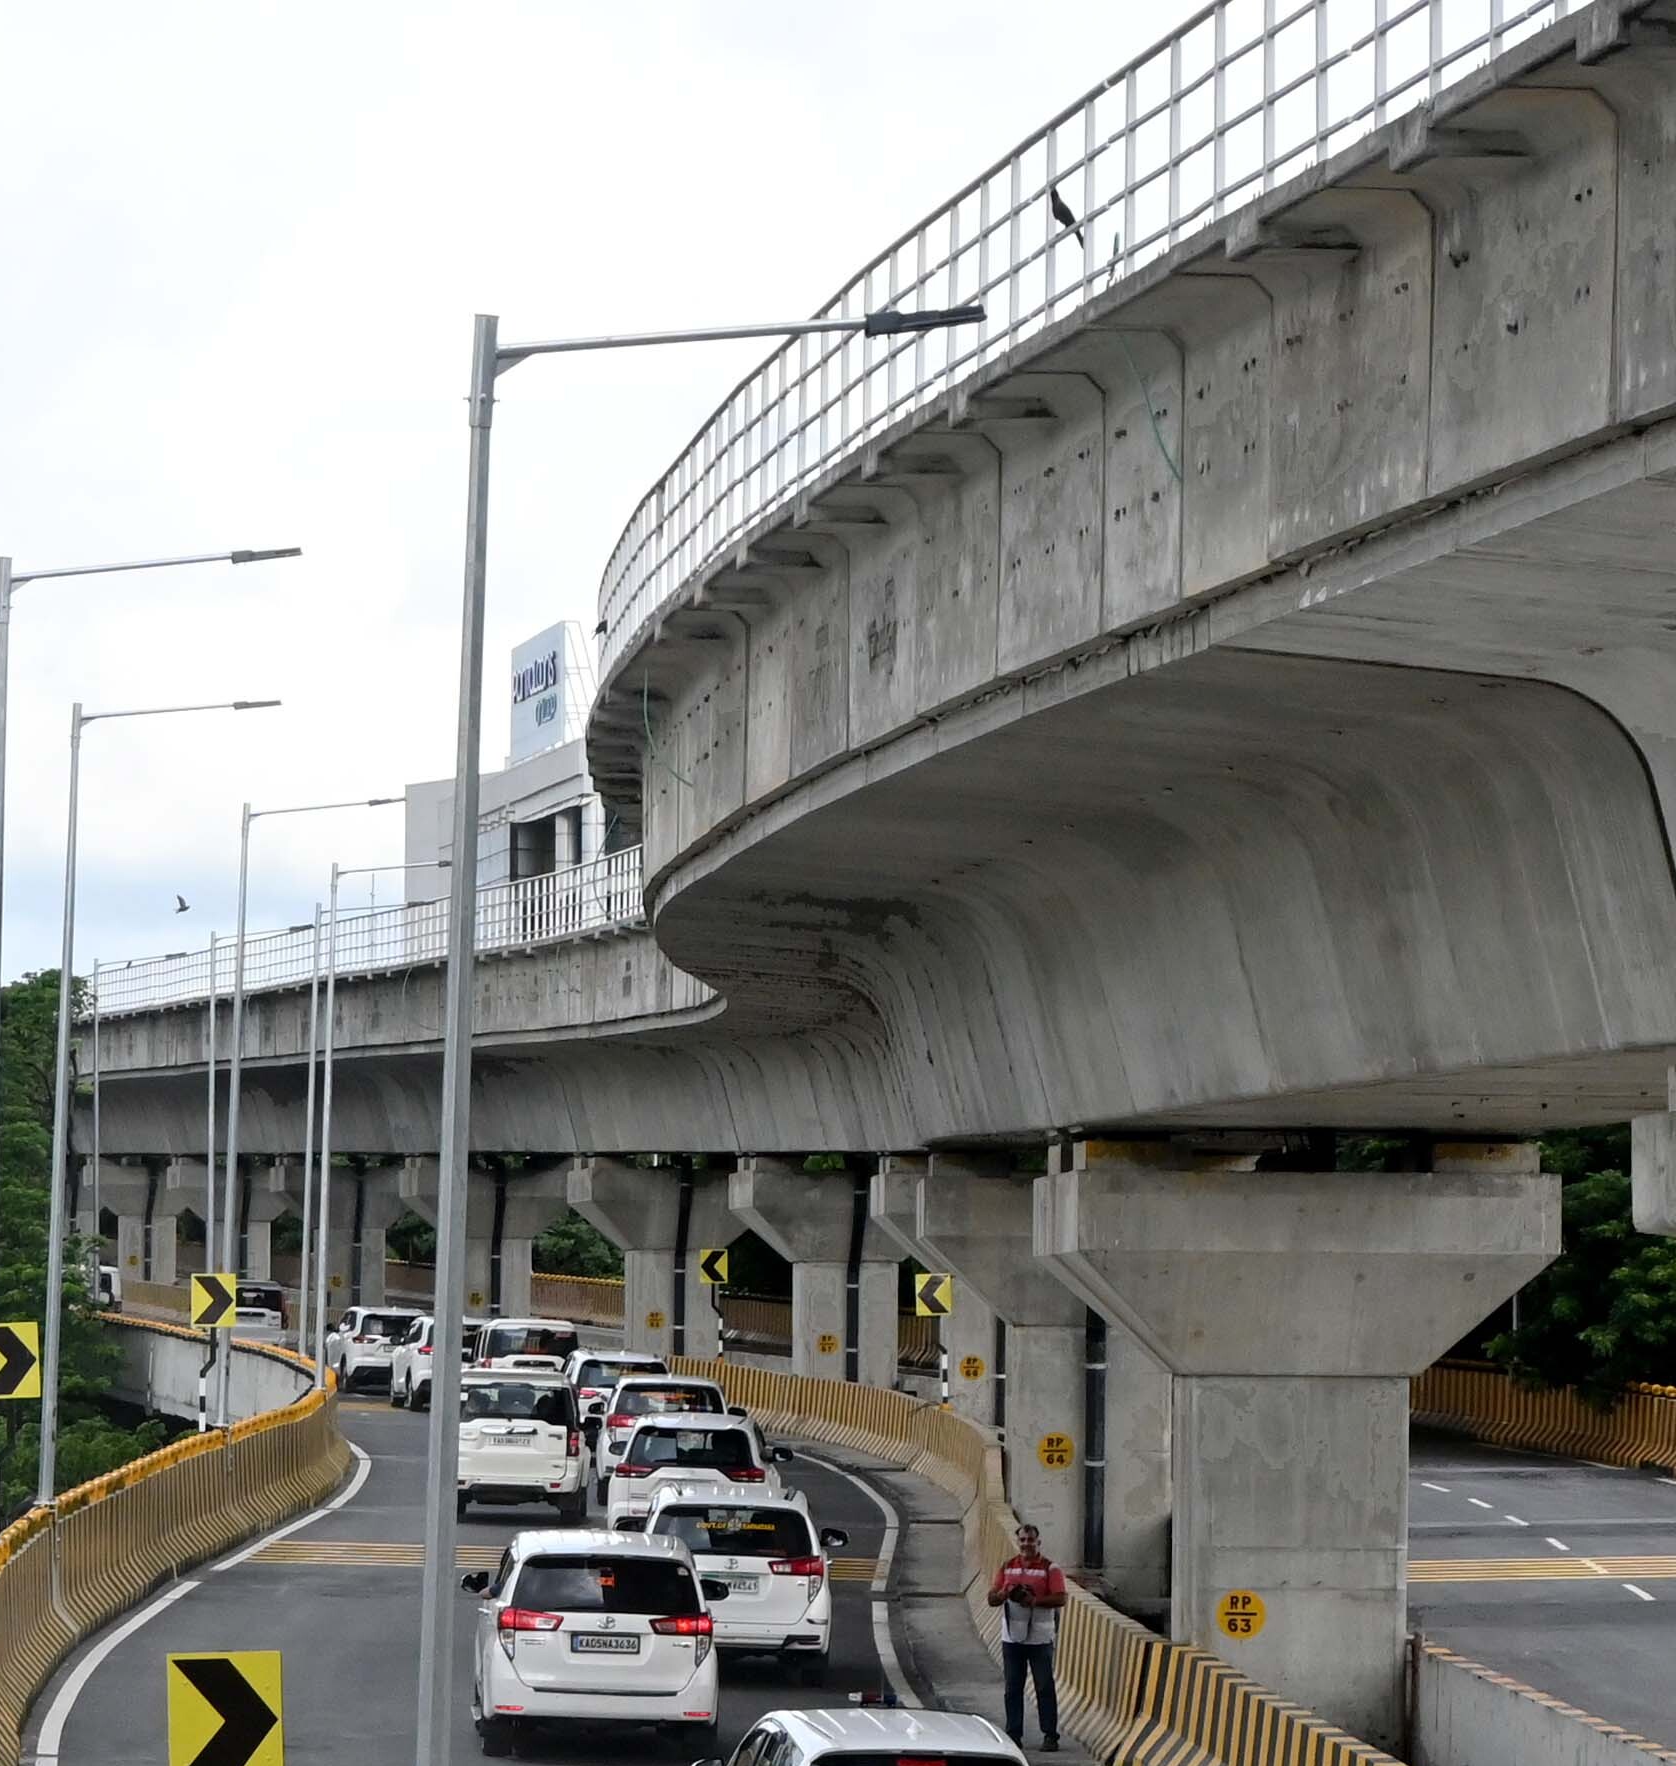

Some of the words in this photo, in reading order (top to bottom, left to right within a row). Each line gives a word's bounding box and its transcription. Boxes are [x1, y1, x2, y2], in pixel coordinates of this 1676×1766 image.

[1047, 1437, 1064, 1448] RP
[1047, 1454, 1065, 1465] 64
[1230, 1595, 1252, 1610] RP
[1228, 1618, 1252, 1633] 63
